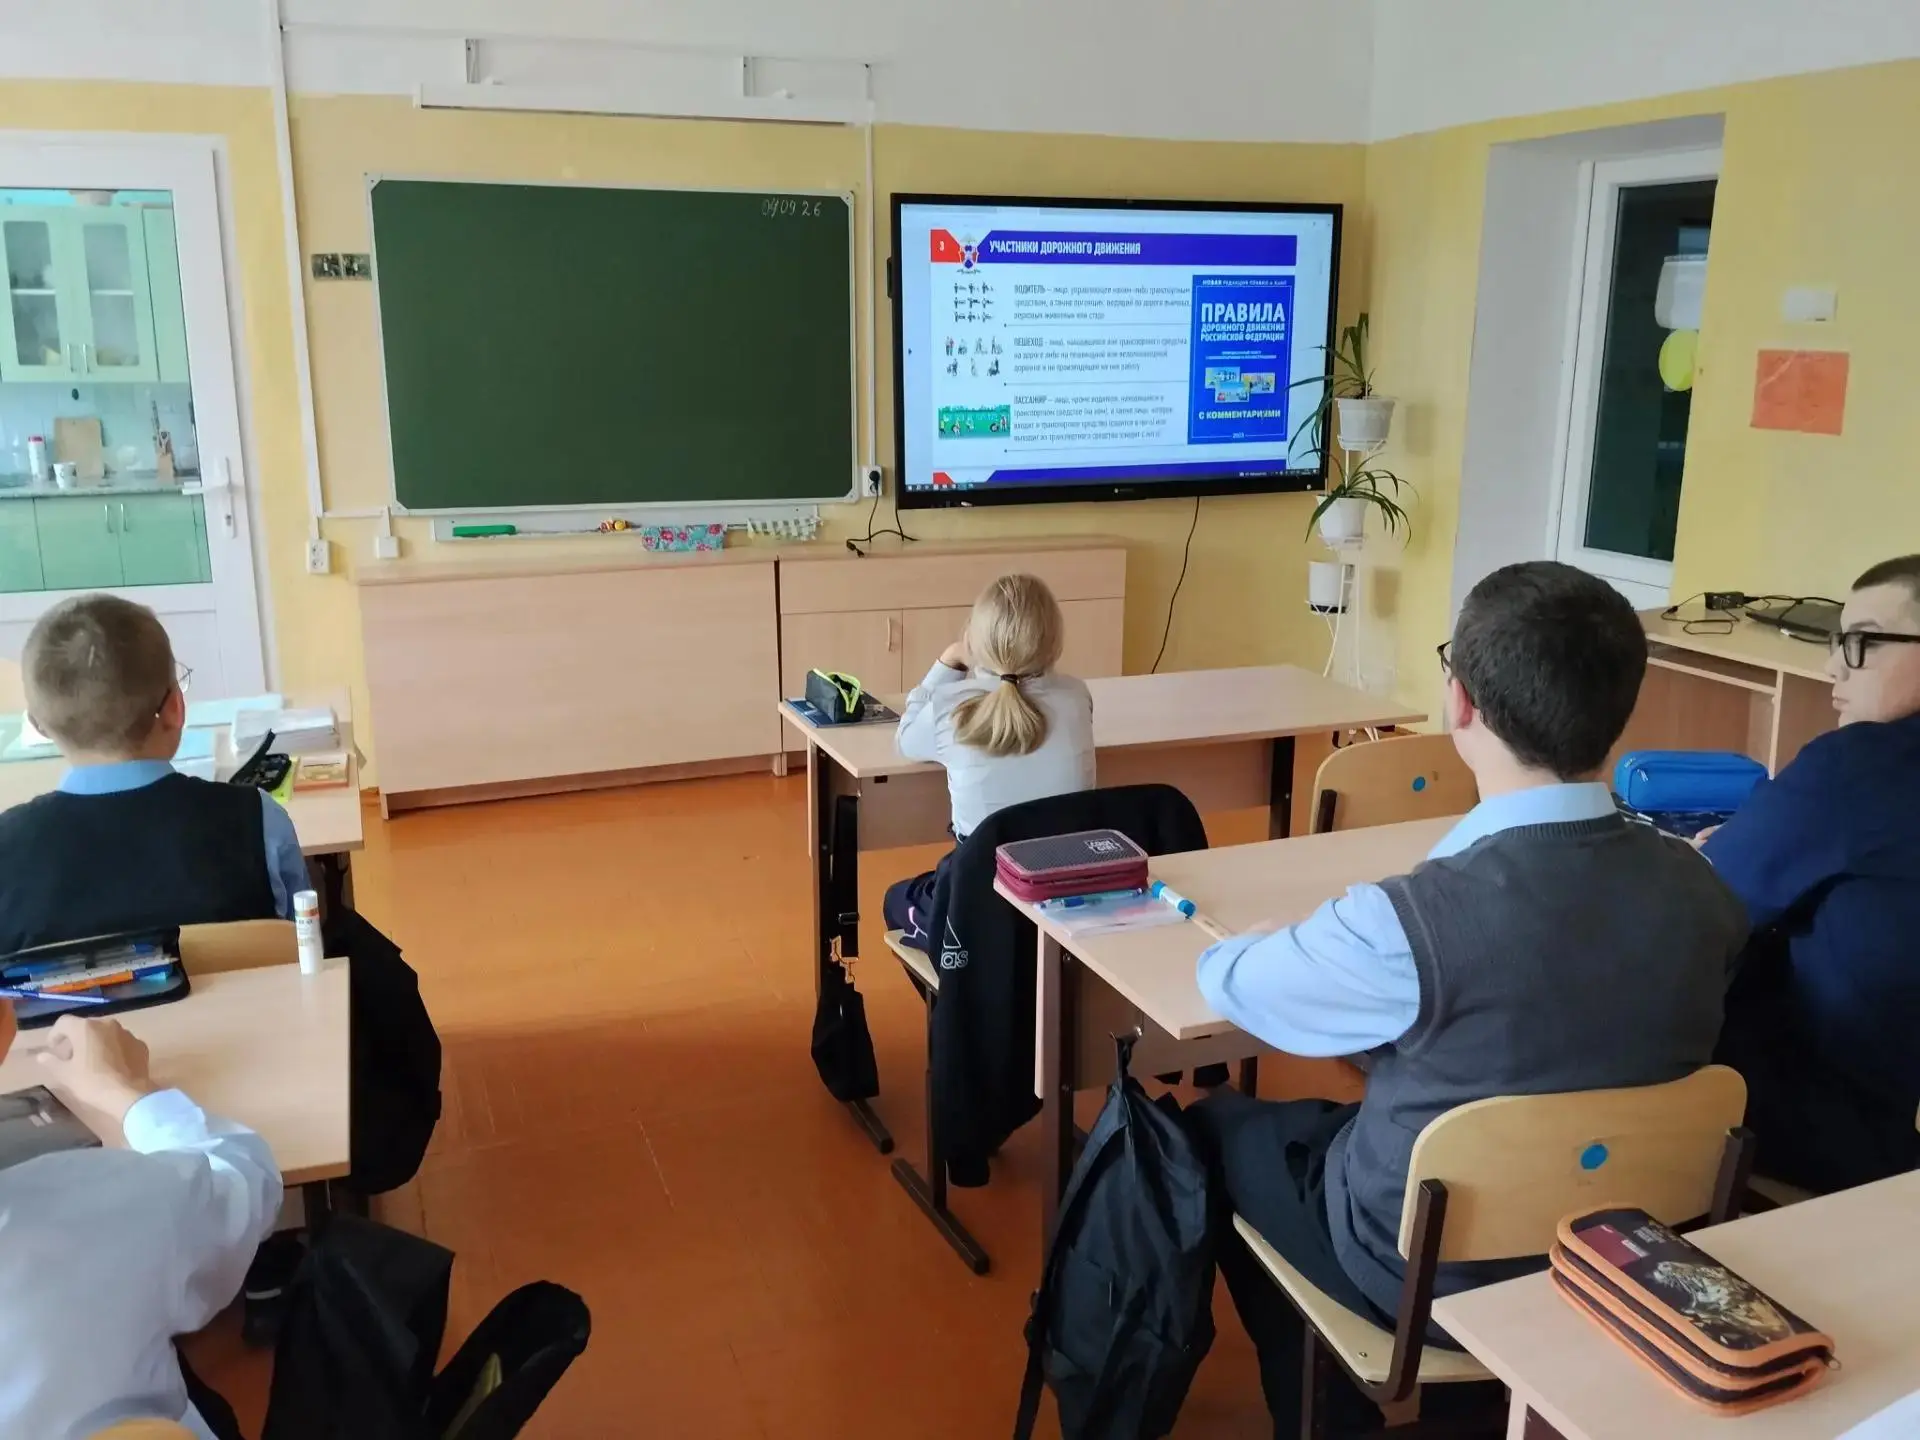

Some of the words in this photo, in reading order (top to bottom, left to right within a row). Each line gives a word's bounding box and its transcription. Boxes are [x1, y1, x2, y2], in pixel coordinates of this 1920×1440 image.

[989, 240, 1038, 252] УЧАСТНИКИ
[1040, 241, 1092, 255] ДОРОЖНОГО
[1094, 242, 1140, 256] ДВИЖЕНИЯ
[1202, 302, 1286, 322] ПРАВИЛА
[1202, 322, 1245, 332] ДОРОЖНОГО
[1246, 322, 1285, 332] ДВИЖЕНИЯ
[1201, 332, 1244, 342] РОССИЙСКОЙ
[1245, 332, 1284, 342] ФЕДЕРАЦИИ
[1199, 411, 1204, 420] С
[1206, 410, 1280, 419] КОММЕНТАРИЯМИ
